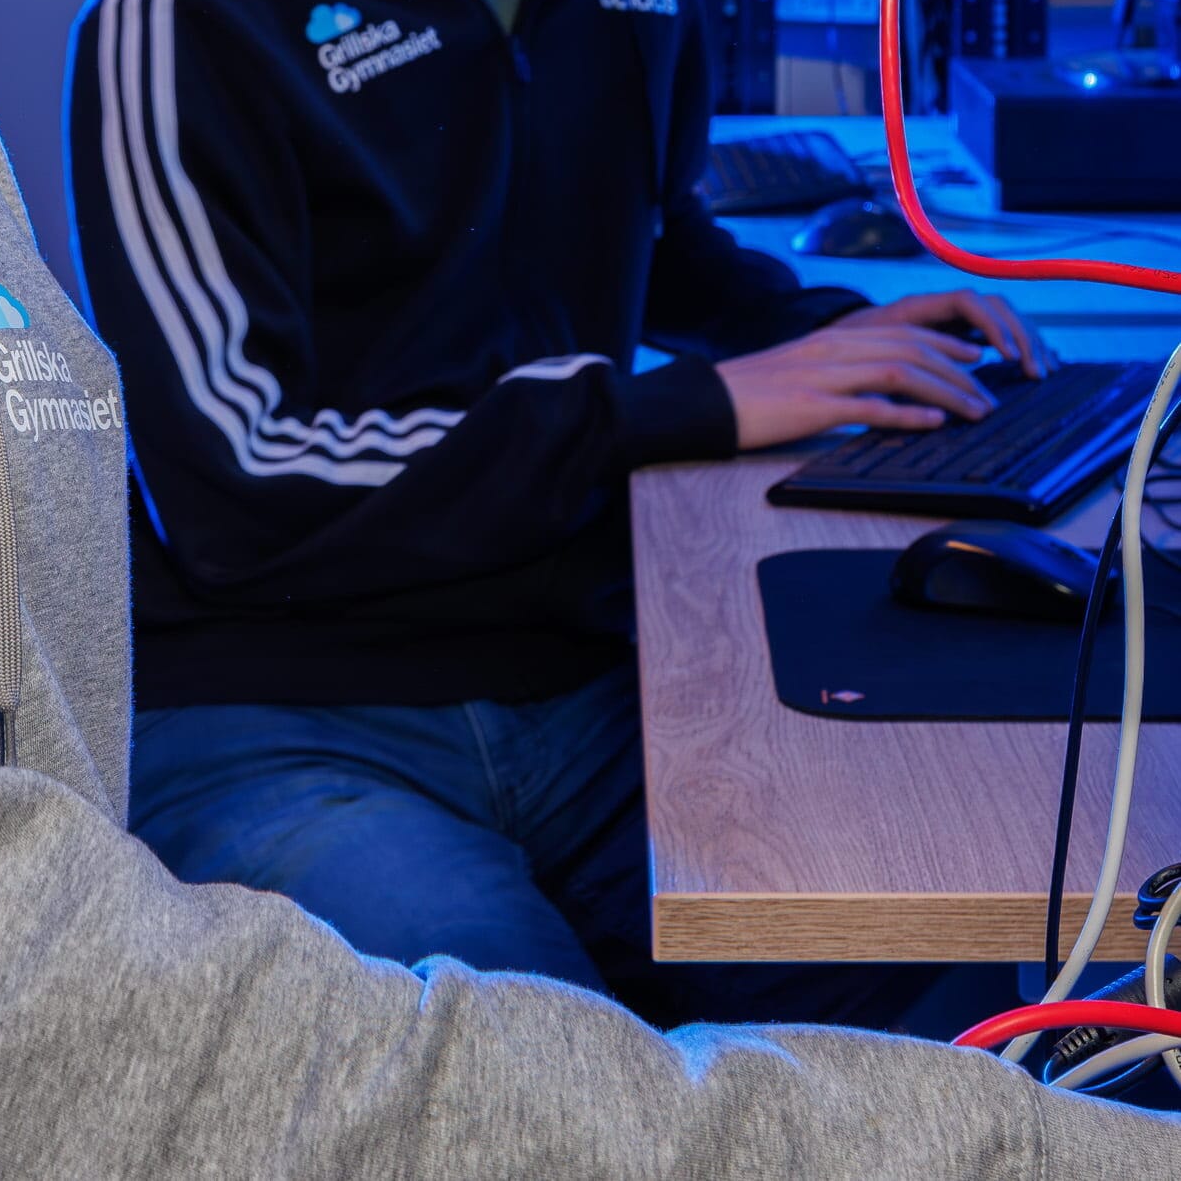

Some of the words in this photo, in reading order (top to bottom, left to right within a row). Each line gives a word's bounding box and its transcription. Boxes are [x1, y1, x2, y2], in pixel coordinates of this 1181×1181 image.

[318, 20, 401, 69] Grillska
[327, 26, 442, 93] Gymnasiet
[5, 388, 122, 442] Gymnasiet
